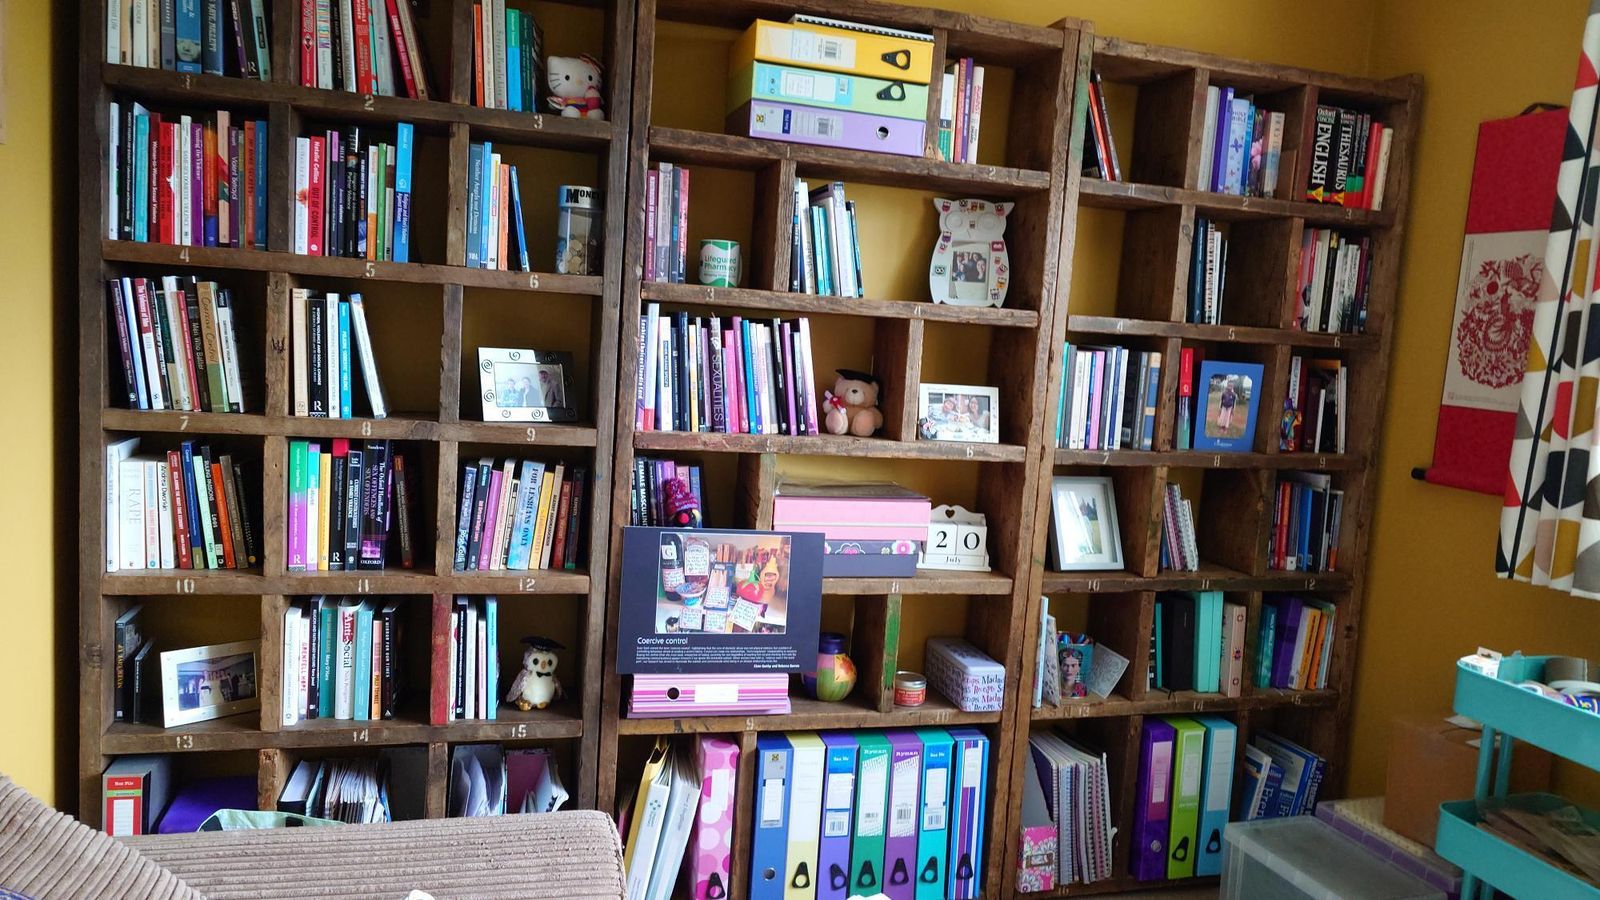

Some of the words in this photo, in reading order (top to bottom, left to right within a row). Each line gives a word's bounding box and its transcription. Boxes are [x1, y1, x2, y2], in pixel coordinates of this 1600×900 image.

[208, 3, 216, 20] KATE
[364, 94, 374, 111] 2
[533, 113, 543, 129] 3
[1311, 123, 1332, 185] ENGLISH
[1335, 125, 1353, 191] THESAURUS
[473, 159, 481, 181] Neither
[989, 167, 996, 179] 2
[311, 188, 319, 199] OUT
[472, 182, 480, 200] Angels
[311, 200, 319, 208] OF
[1242, 197, 1248, 209] 2
[311, 211, 319, 238] CONTROL
[179, 248, 190, 262] 4
[365, 262, 375, 277] 5
[138, 285, 146, 293] The
[530, 274, 539, 289] 6
[706, 289, 714, 300] 3
[202, 297, 211, 329] Coercive
[1116, 321, 1123, 333] 4
[1228, 328, 1235, 340] 5
[205, 332, 217, 363] Control
[1334, 335, 1340, 347] 6
[196, 352, 204, 370] Batter
[711, 355, 724, 421] SEXUALITIES
[180, 416, 190, 430] 7
[362, 420, 372, 435] 8
[526, 426, 536, 442] 9
[966, 445, 974, 458] 6
[1103, 452, 1110, 464] 7
[1213, 455, 1220, 467] 8
[1319, 456, 1326, 468] 9
[160, 465, 168, 486] Andrea
[530, 468, 539, 483] FOR
[160, 488, 168, 511] Dworkin
[363, 480, 371, 515] OFFENDERS
[370, 477, 378, 508] OFFENCES
[128, 488, 142, 524] RAPE
[205, 479, 214, 501] PASSIONS
[211, 514, 219, 528] Lees
[524, 487, 537, 525] LESBIANS
[458, 529, 467, 543] Rose
[520, 527, 529, 547] ONLY
[936, 530, 948, 549] 2
[945, 556, 961, 565] July
[176, 578, 194, 594] 10
[358, 578, 369, 592] 11
[520, 577, 536, 591] 12
[342, 615, 353, 678] Anti-Social
[665, 637, 688, 645] control
[511, 724, 527, 738] 15
[746, 718, 754, 730] 9
[176, 734, 193, 748] 13
[353, 728, 368, 742] 14
[863, 748, 887, 756] Ryman
[895, 750, 919, 758] Ryman
